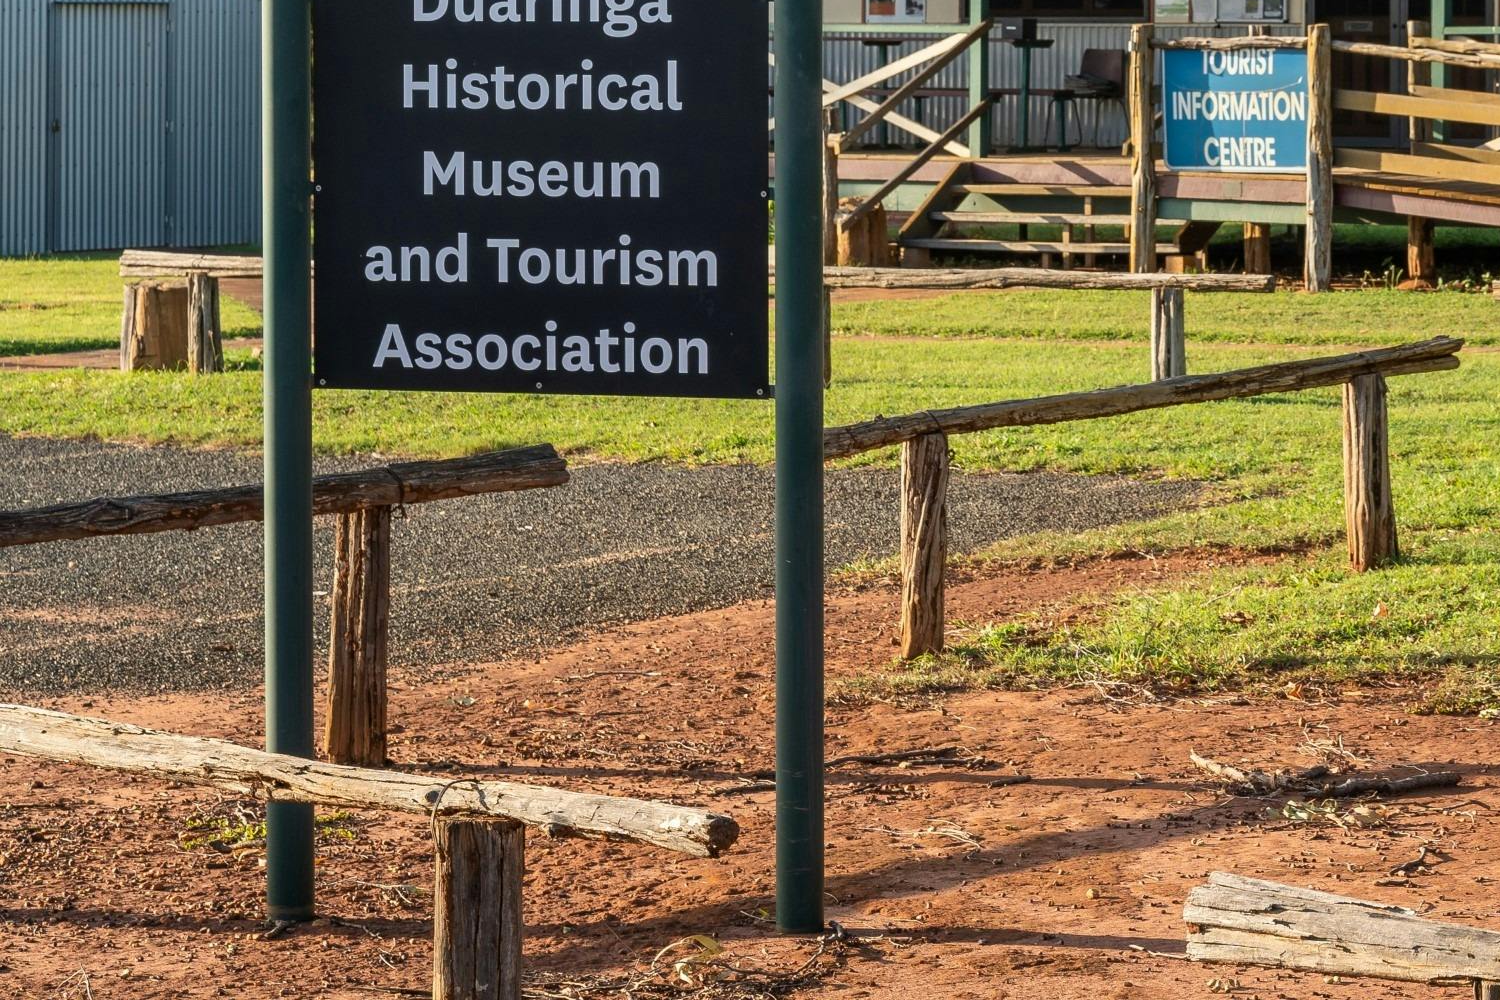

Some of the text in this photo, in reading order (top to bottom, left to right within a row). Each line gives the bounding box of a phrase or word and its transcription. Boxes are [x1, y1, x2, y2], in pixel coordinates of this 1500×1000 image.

[403, 57, 683, 111] Historical
[1201, 49, 1275, 75] TOURIST
[1173, 91, 1305, 121] INFORMATION
[423, 150, 660, 198] Museum
[1204, 137, 1276, 166] CENTRE
[364, 232, 718, 287] and Tourism
[372, 320, 709, 375] Association
